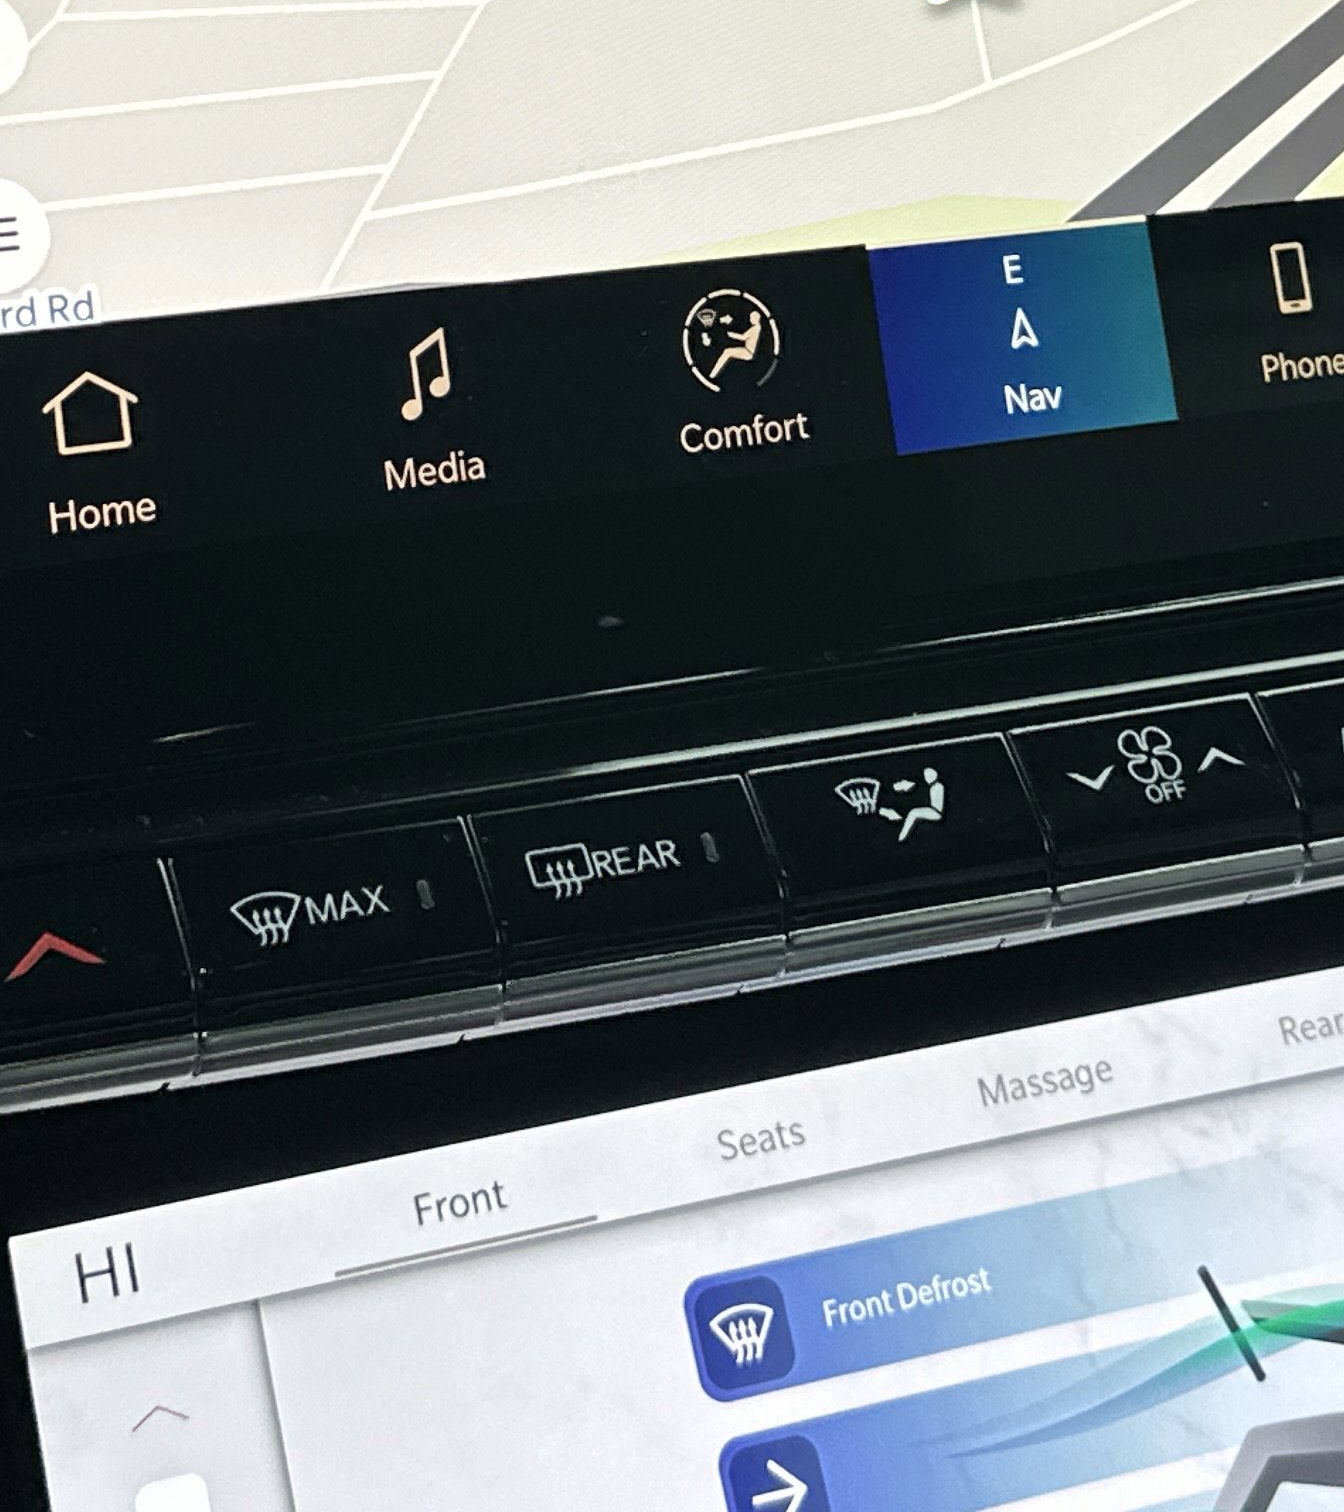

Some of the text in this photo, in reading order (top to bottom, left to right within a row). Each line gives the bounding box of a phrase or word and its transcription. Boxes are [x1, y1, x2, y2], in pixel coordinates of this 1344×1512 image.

[1002, 254, 1023, 285] E
[47, 291, 95, 322] Rd
[1003, 383, 1062, 414] Nav
[678, 412, 810, 454] Comfort
[383, 450, 487, 492] Media
[47, 496, 158, 535] Home
[1144, 779, 1186, 805] OFF
[591, 838, 681, 880] REAR
[303, 884, 391, 925] MAX
[1278, 1008, 1344, 1046] Rear
[976, 1057, 1115, 1108] Massage
[716, 1119, 807, 1161] Seats
[413, 1180, 509, 1227] Front
[74, 1242, 141, 1304] HI
[823, 1266, 993, 1329] Front Defrost
